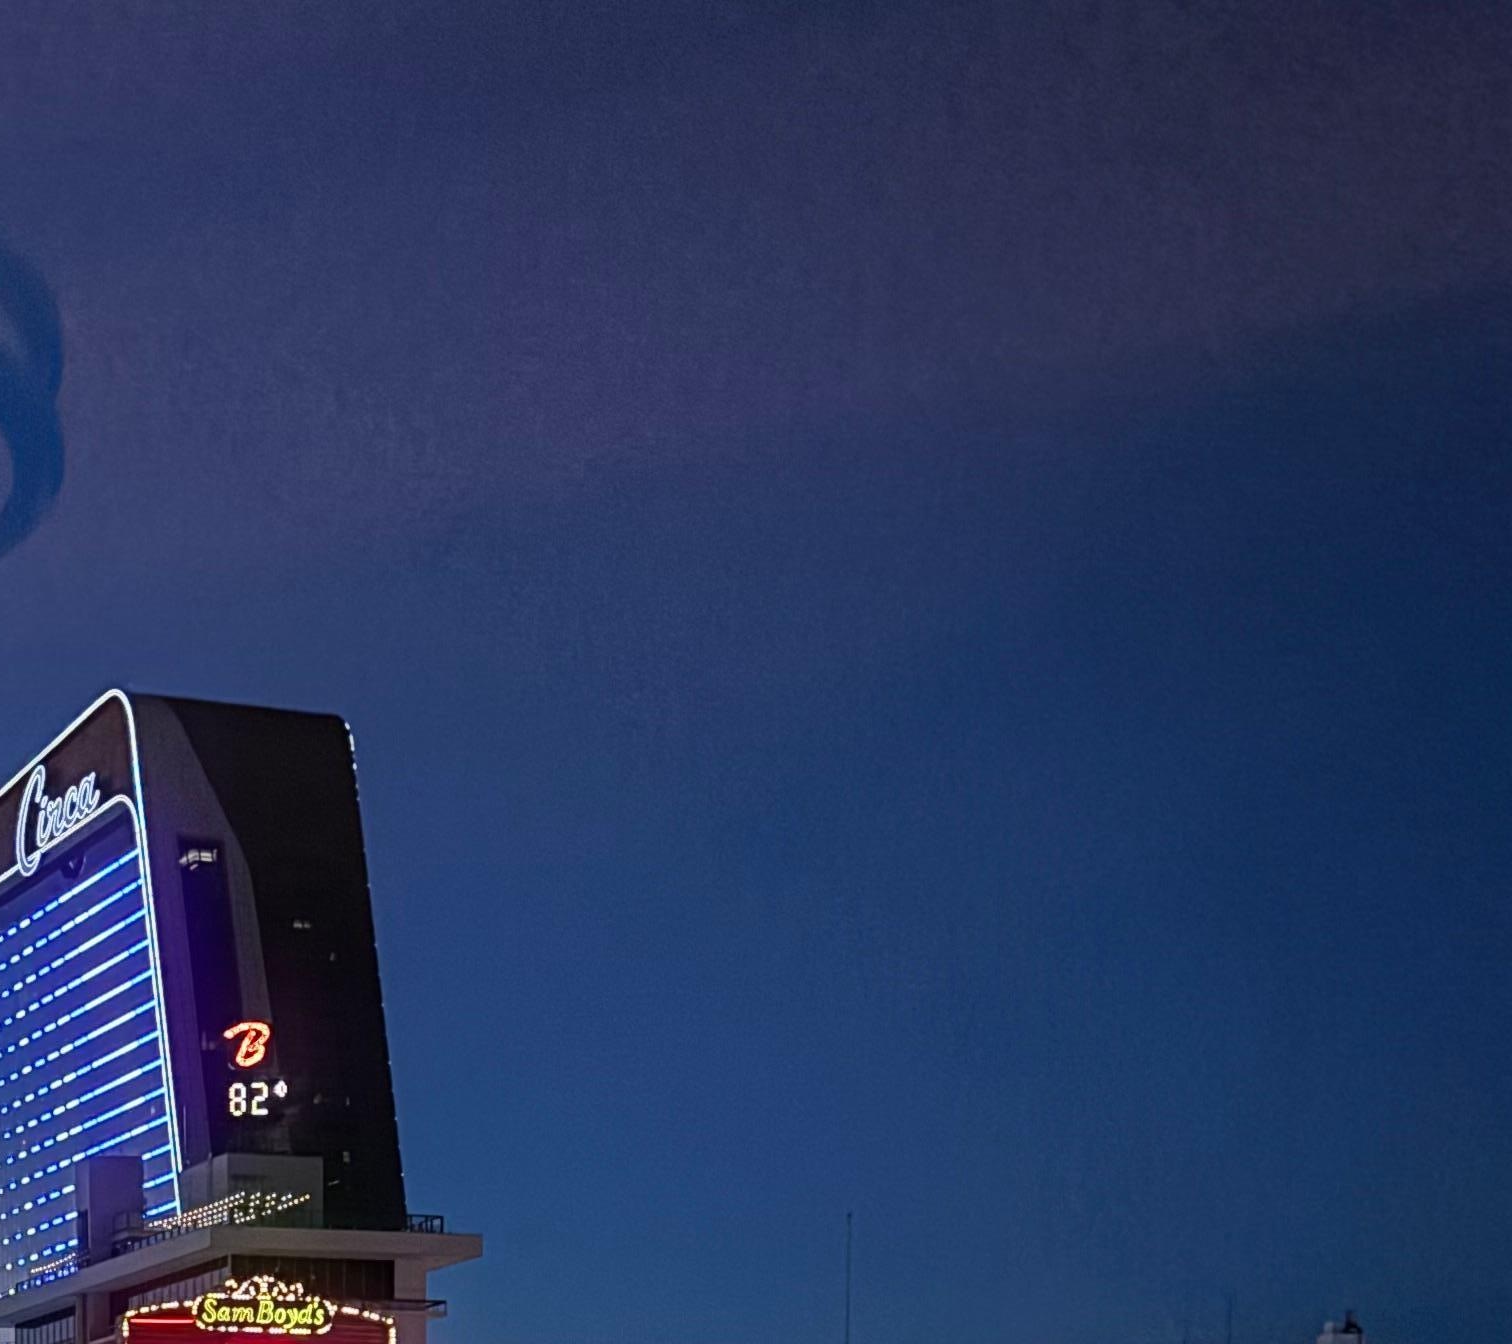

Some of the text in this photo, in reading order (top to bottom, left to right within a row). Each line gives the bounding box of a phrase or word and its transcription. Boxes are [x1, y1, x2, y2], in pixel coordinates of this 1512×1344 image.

[16, 764, 101, 877] Circa
[201, 1298, 325, 1329] Sam Boyd's
